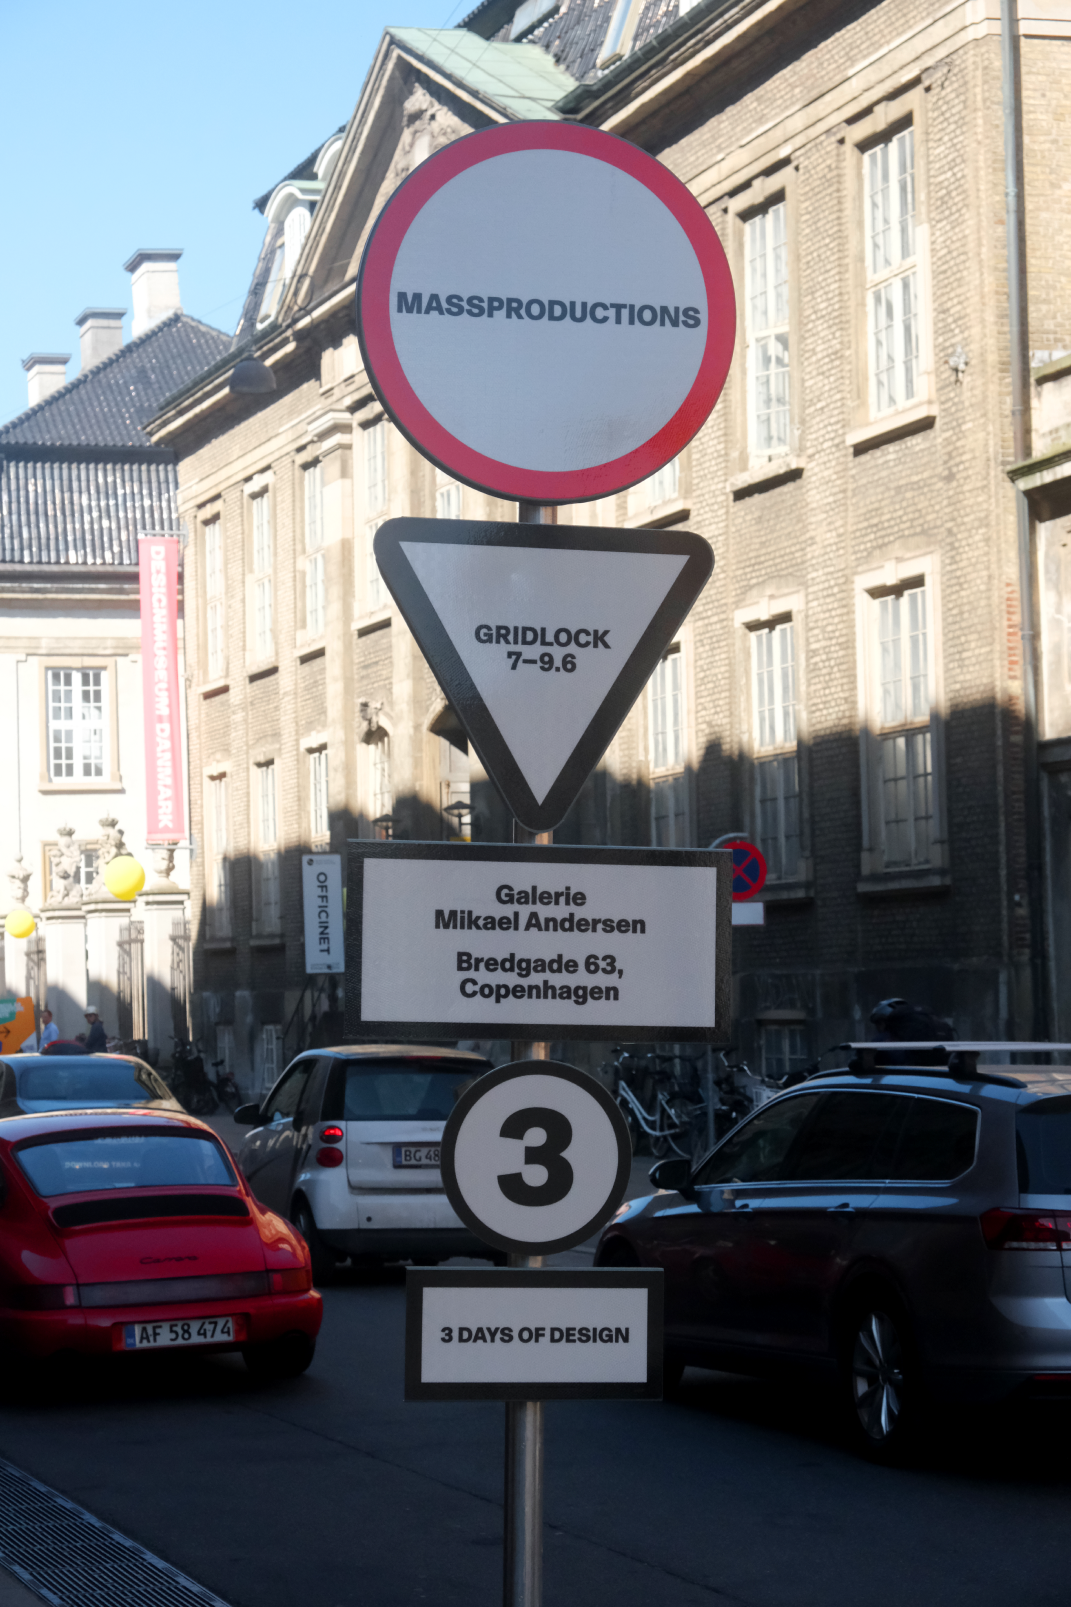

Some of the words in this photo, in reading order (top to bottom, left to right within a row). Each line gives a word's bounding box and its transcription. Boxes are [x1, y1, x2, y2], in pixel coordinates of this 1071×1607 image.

[397, 291, 701, 329] MASSPRODUCTIONS
[150, 544, 171, 716] DESIGNMUSEUM
[474, 625, 611, 650] GRIDLOCK
[155, 722, 175, 830] DANMARK
[496, 884, 587, 907] Galerie
[316, 871, 331, 956] OFFICINET
[435, 909, 519, 931] Mikael
[524, 911, 647, 934] Andersen
[457, 951, 579, 978] Bredgade
[584, 954, 624, 979] 63,
[460, 978, 620, 1005] Copenhagen
[404, 1149, 422, 1162] BG
[497, 1107, 574, 1207] 3
[139, 1325, 162, 1344] AF
[169, 1323, 192, 1341] 58
[197, 1320, 231, 1340] 474
[441, 1326, 454, 1344] 3
[457, 1326, 514, 1344] DAYS
[517, 1326, 546, 1344] OF
[549, 1326, 629, 1344] DESIGN
